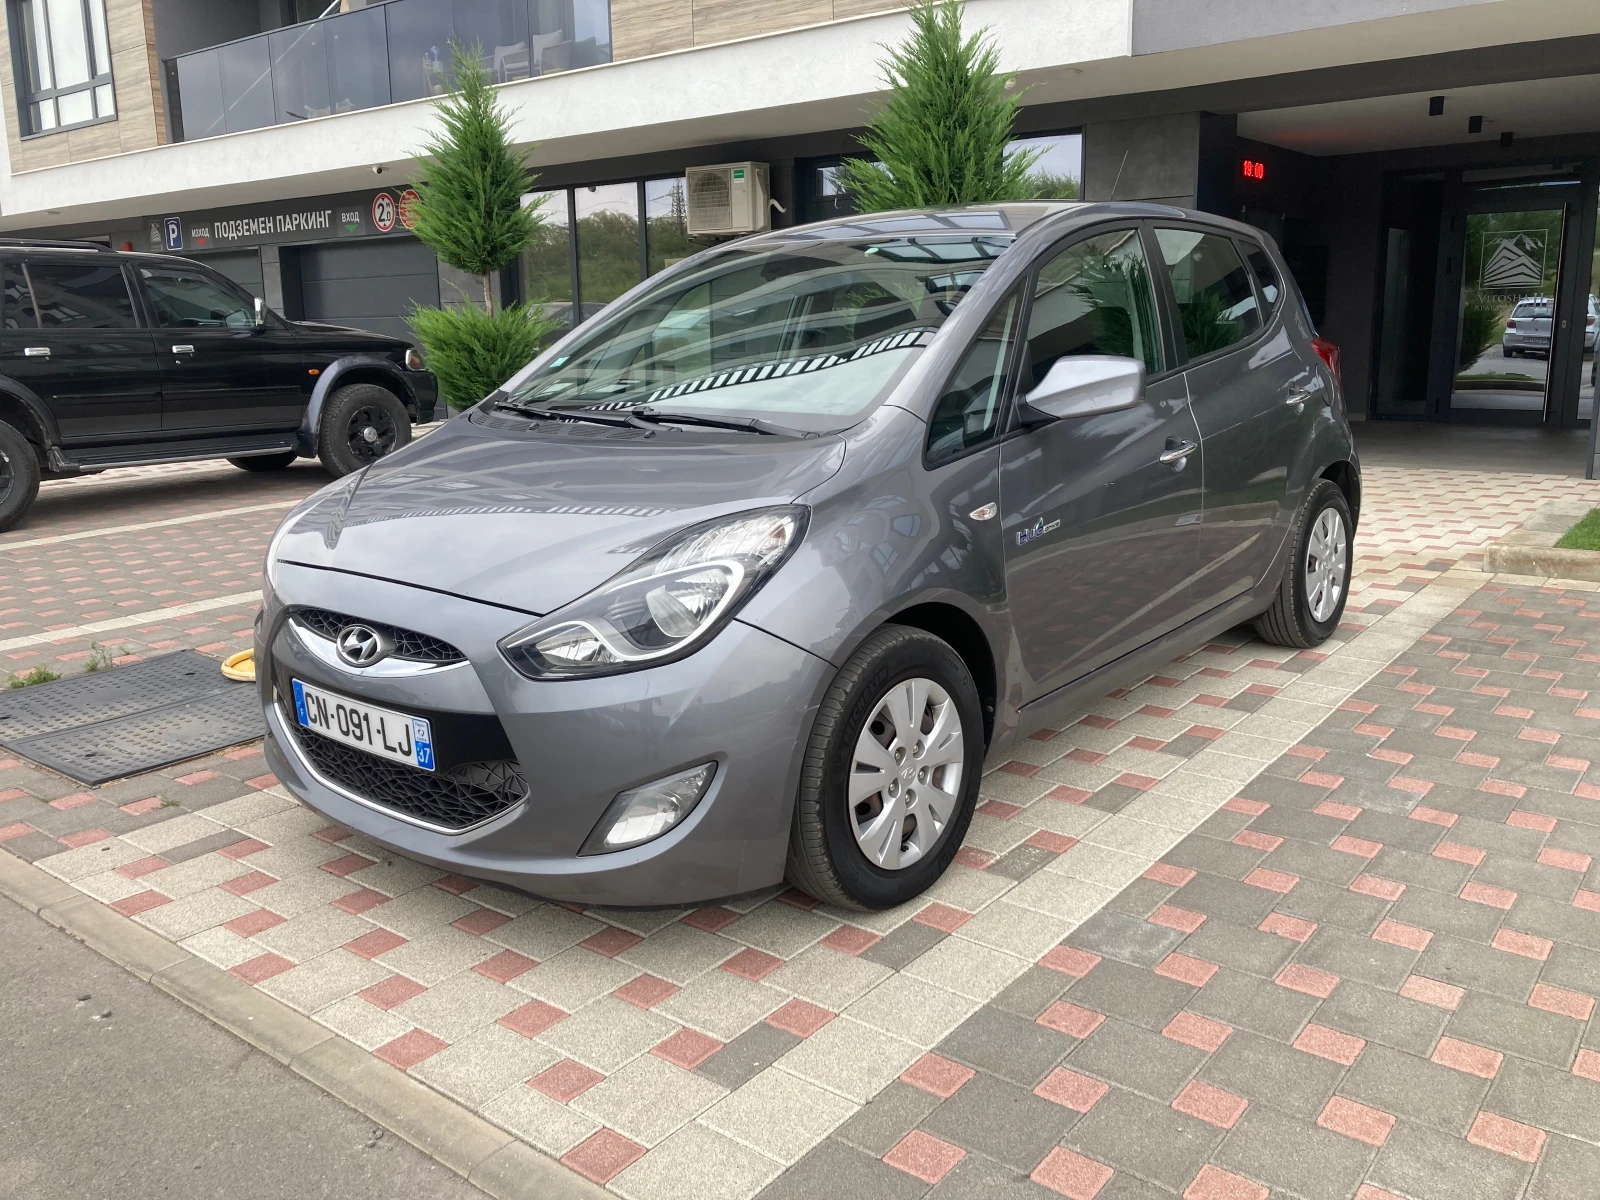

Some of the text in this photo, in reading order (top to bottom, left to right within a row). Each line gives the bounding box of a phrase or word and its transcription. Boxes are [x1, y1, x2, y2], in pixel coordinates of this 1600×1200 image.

[214, 209, 332, 240] ПОДЗЕМЕН ПАРКИНГ
[341, 211, 360, 224] ВХОД
[304, 691, 412, 757] CN-091-LJ
[416, 746, 430, 764] 37
